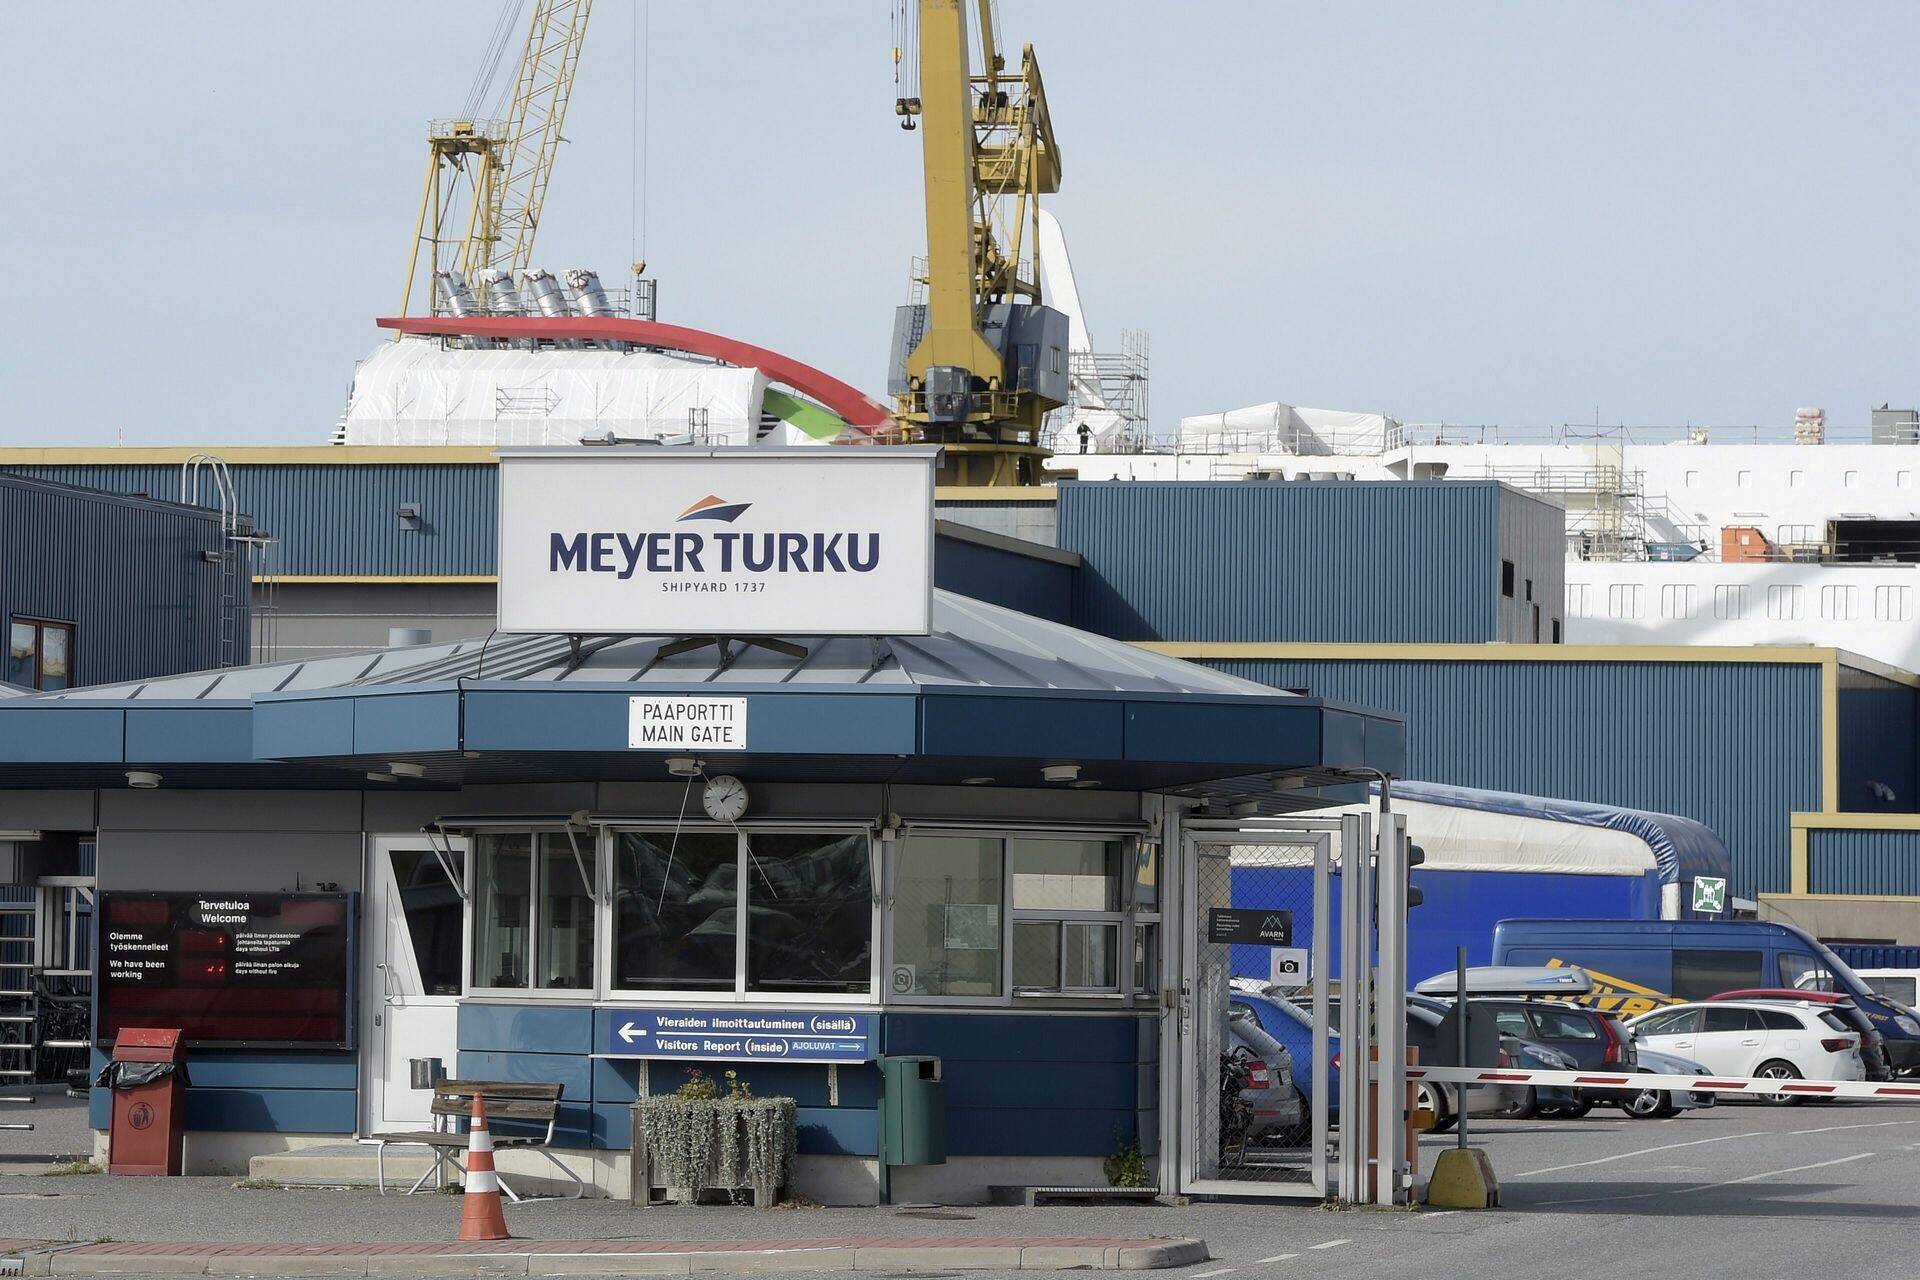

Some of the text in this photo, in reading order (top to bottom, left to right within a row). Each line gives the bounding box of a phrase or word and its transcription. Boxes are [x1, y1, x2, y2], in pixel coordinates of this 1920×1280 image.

[550, 532, 880, 579] MEYER TURKU
[661, 582, 766, 593] SHIPYARD 1737
[642, 725, 733, 742] MAIN GATE
[199, 900, 250, 910] Tervetuloa
[201, 914, 247, 923] Welcome
[109, 932, 143, 940] Olemme
[110, 943, 169, 952] työskennelleet
[109, 960, 165, 968] We have been
[110, 970, 142, 980] working
[656, 1016, 856, 1033] Vieraiden ilmoittautuminen (sisällä)
[656, 1038, 836, 1056] Visitors Report (inside) AJOLUVAT
